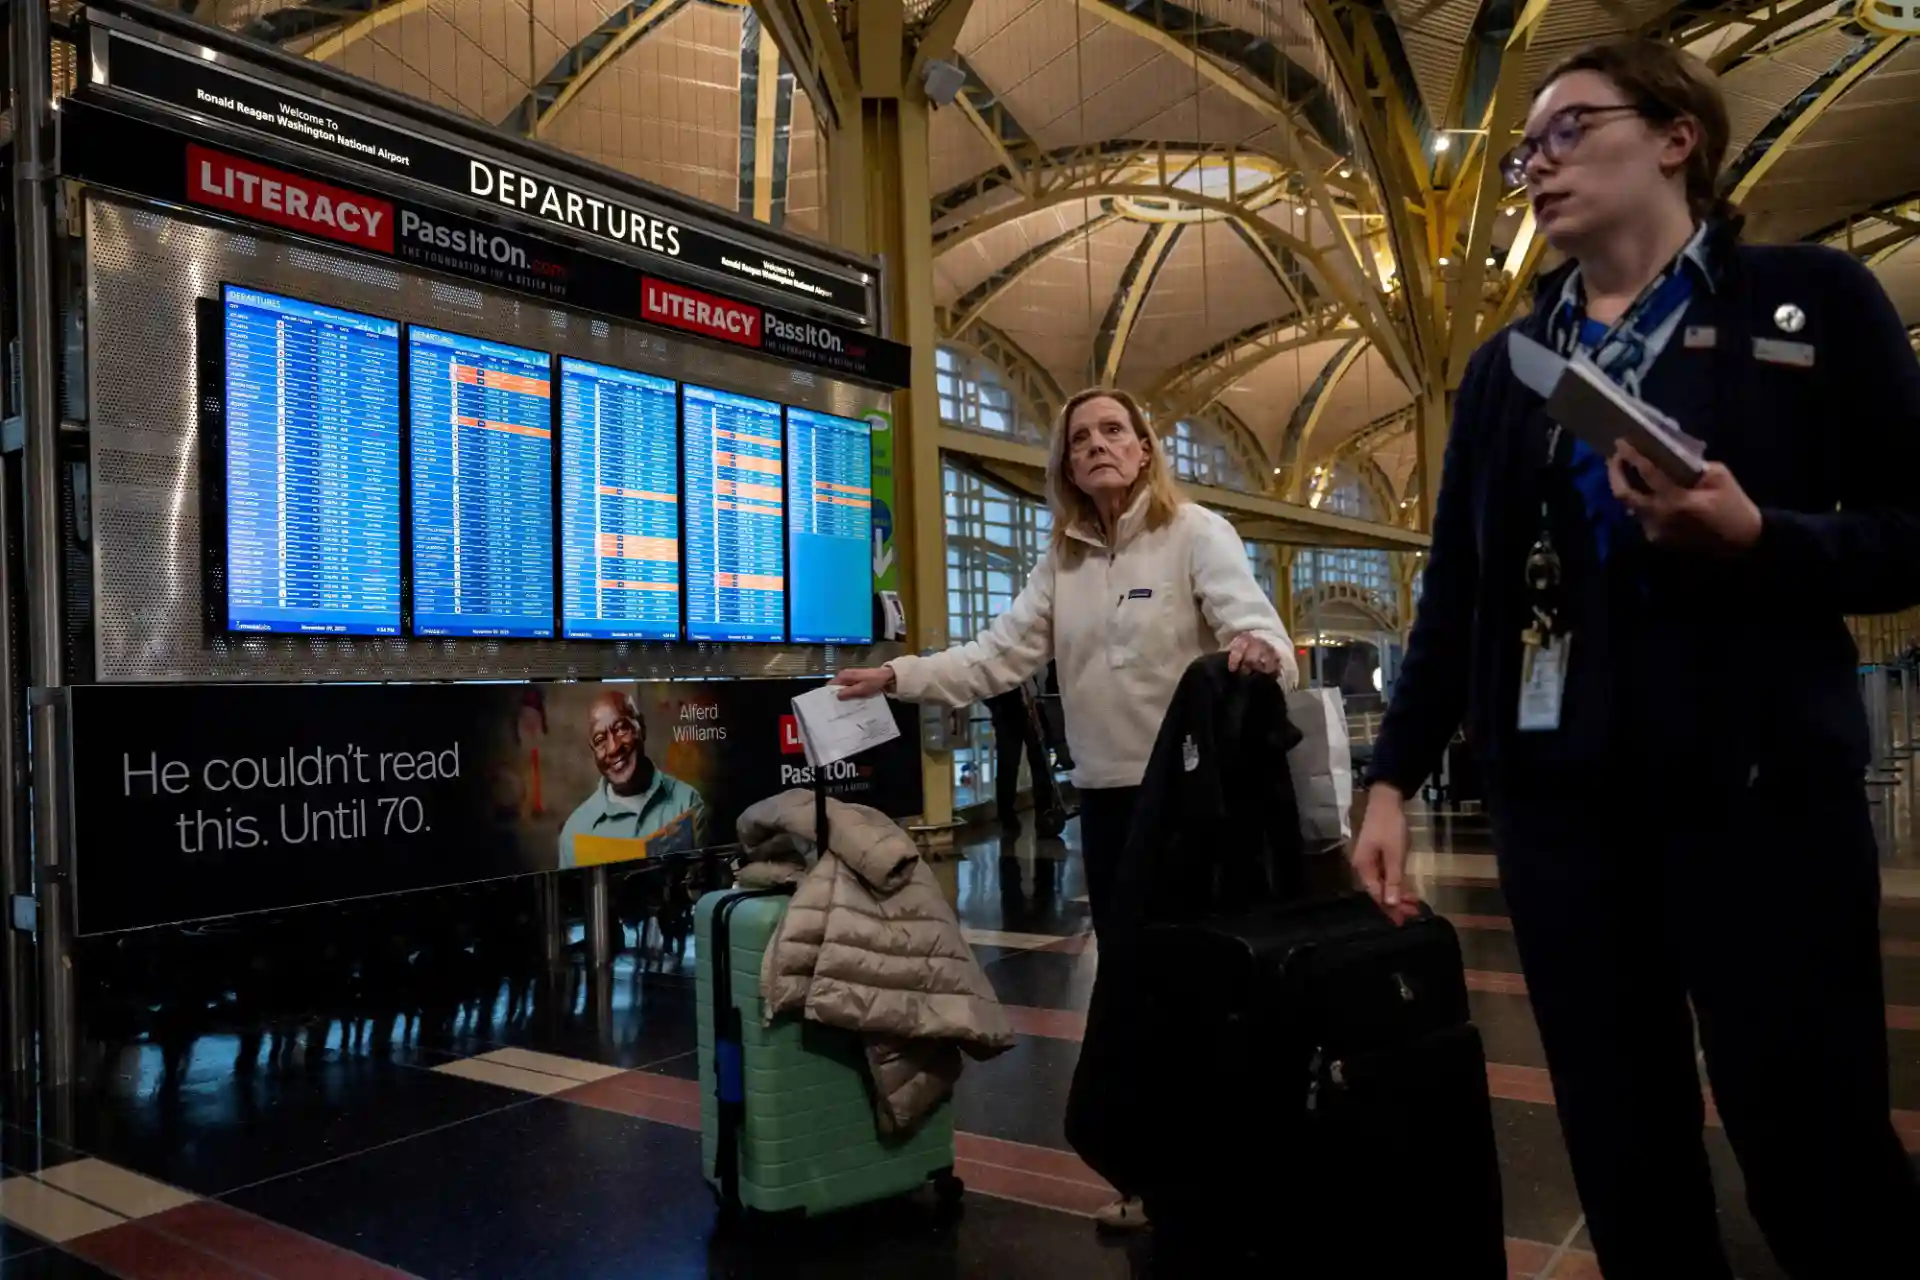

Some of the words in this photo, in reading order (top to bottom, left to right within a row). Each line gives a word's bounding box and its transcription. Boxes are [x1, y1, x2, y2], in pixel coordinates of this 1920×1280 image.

[196, 88, 235, 111] Ronald
[236, 101, 275, 123] Reagan
[276, 115, 335, 143] Washington
[337, 134, 376, 155] National
[378, 147, 410, 166] Airport
[279, 102, 324, 127] Welcome
[326, 118, 339, 131] To
[201, 160, 384, 238] LITERACY
[470, 160, 681, 256] DEPARTURES
[648, 287, 755, 337] LITERACY
[672, 725, 727, 743] Williams
[680, 703, 718, 723] Alferd
[124, 751, 190, 796] He
[203, 743, 370, 792] couldn't
[379, 741, 460, 782] read
[176, 807, 269, 853] this.
[280, 798, 367, 845] Until
[377, 795, 432, 836] 70.
